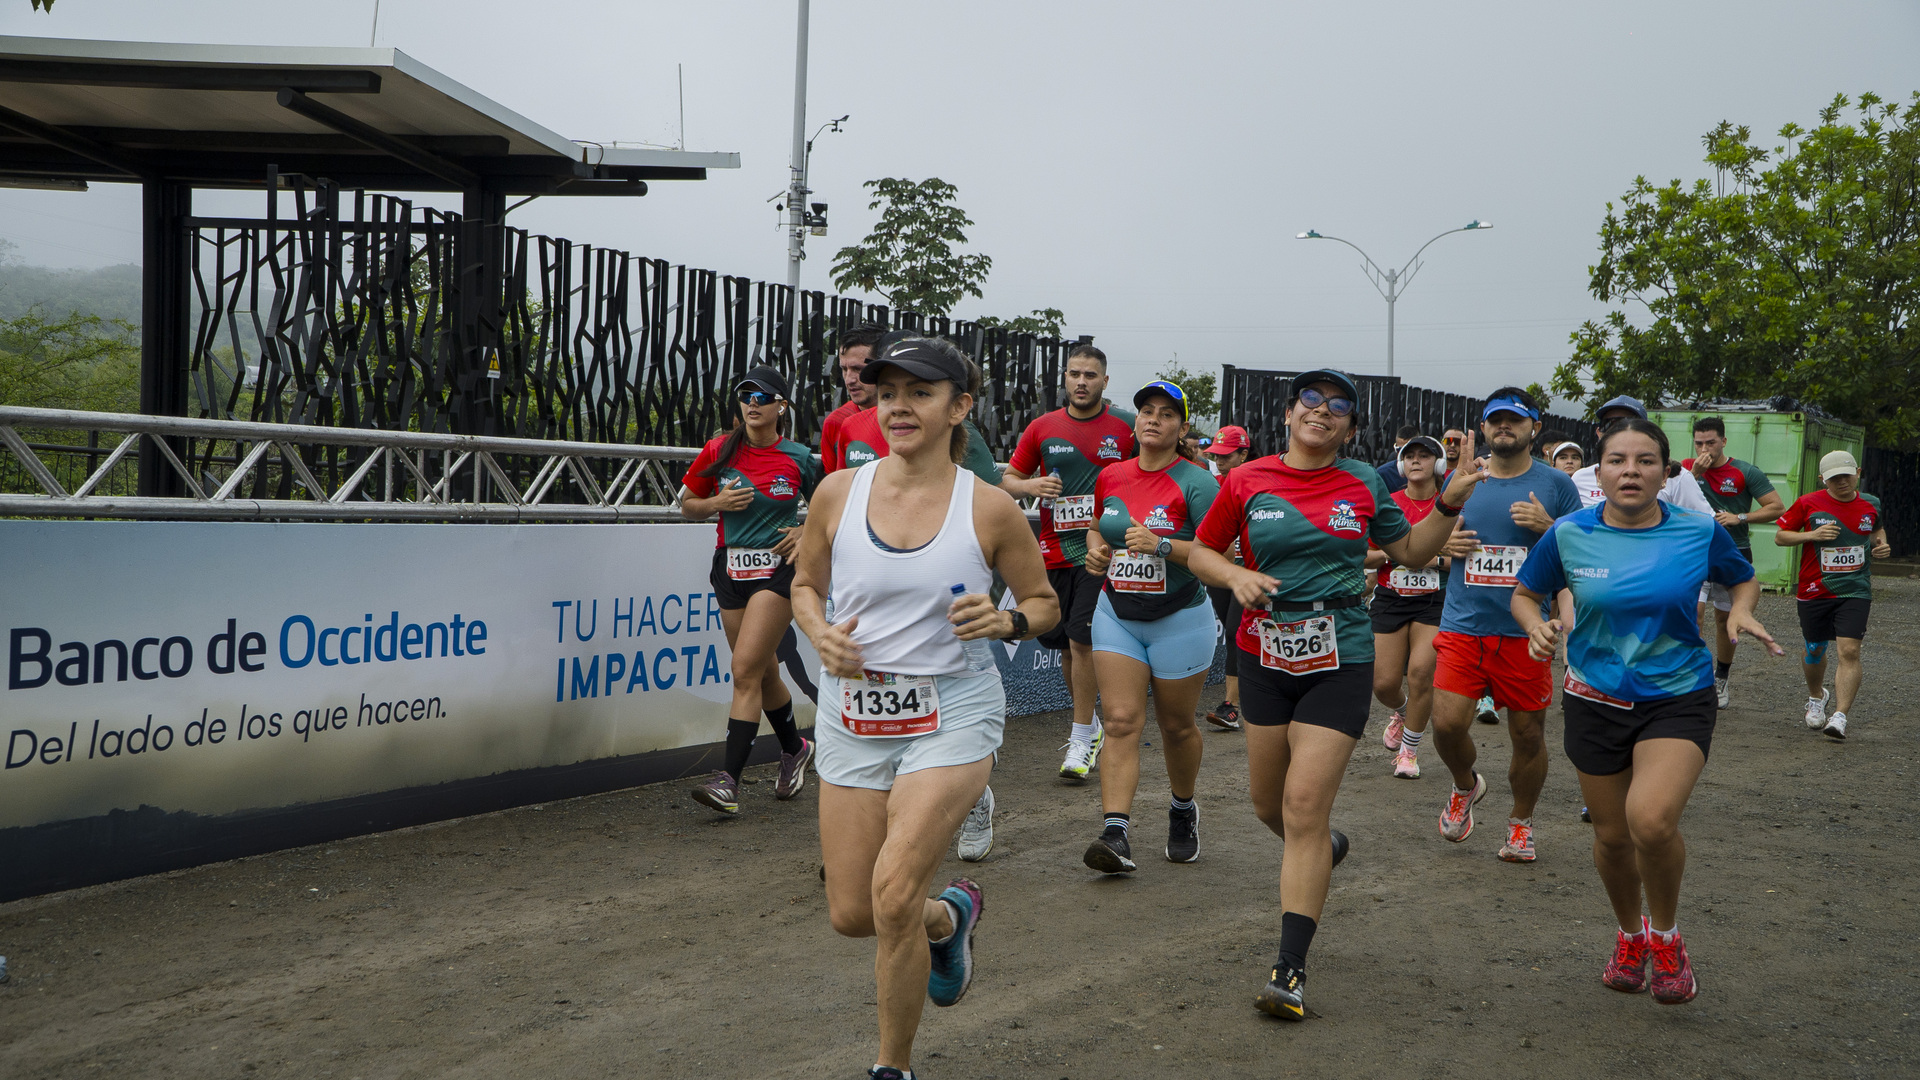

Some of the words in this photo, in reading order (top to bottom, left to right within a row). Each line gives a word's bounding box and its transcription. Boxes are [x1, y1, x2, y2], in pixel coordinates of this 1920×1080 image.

[1060, 506, 1093, 520] 1134
[735, 552, 771, 568] 1063
[1115, 562, 1155, 579] 2040
[1475, 557, 1513, 573] 1441
[1832, 554, 1855, 565] 408
[1402, 575, 1427, 587] 136
[552, 598, 597, 643] TU
[613, 592, 722, 639] HACER
[8, 627, 194, 690] Banco
[206, 618, 267, 674] de
[279, 610, 488, 669] Occidente
[1272, 634, 1322, 658] 1626
[1033, 648, 1052, 670] Del
[556, 644, 731, 703] IMPACTA.
[853, 688, 920, 715] 1334
[5, 721, 77, 769] Del
[88, 714, 174, 760] lado
[184, 708, 227, 747] de
[238, 704, 283, 740] los
[293, 706, 348, 743] que
[357, 693, 447, 727] hacen.
